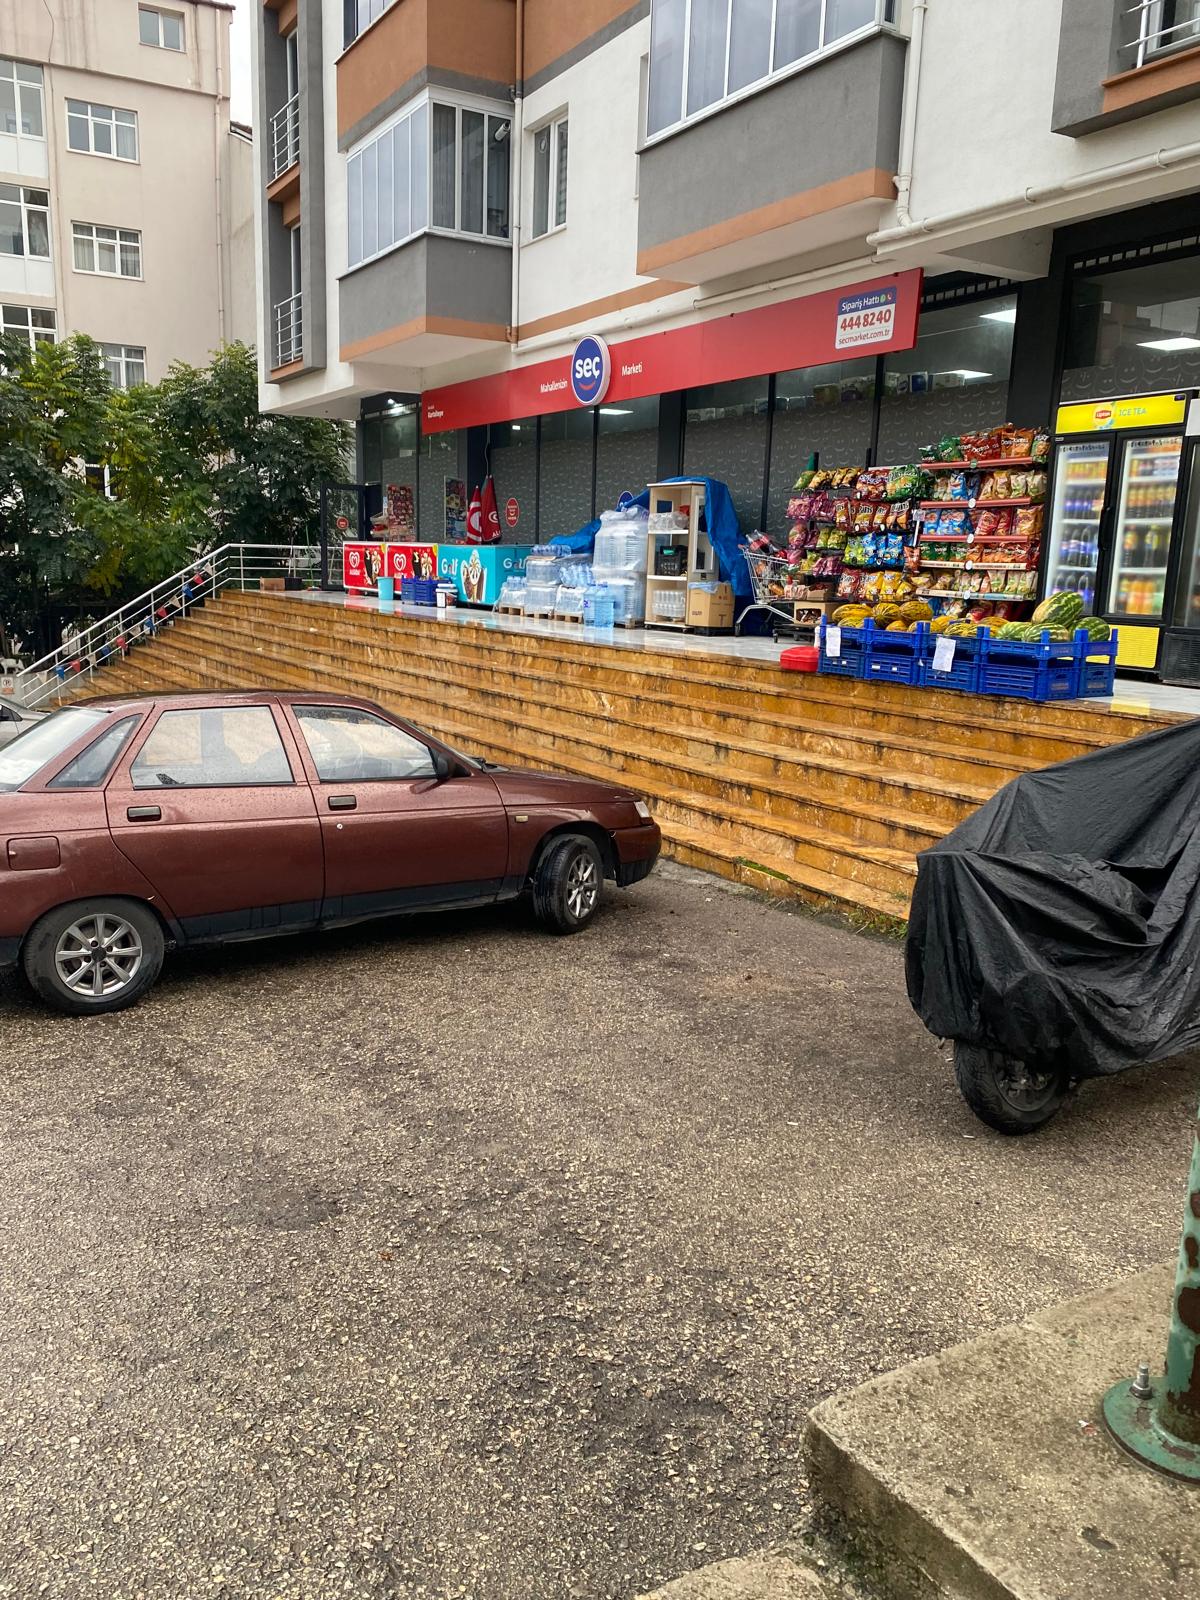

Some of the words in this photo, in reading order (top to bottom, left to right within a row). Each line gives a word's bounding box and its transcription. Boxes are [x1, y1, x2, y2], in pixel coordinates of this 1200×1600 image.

[841, 299, 863, 312] Sipariş
[863, 296, 880, 307] Hattı
[839, 329, 890, 345] secmarket.com.tr
[540, 379, 568, 393] Mahallenizin
[575, 356, 601, 379] seç
[621, 362, 643, 376] Marketi
